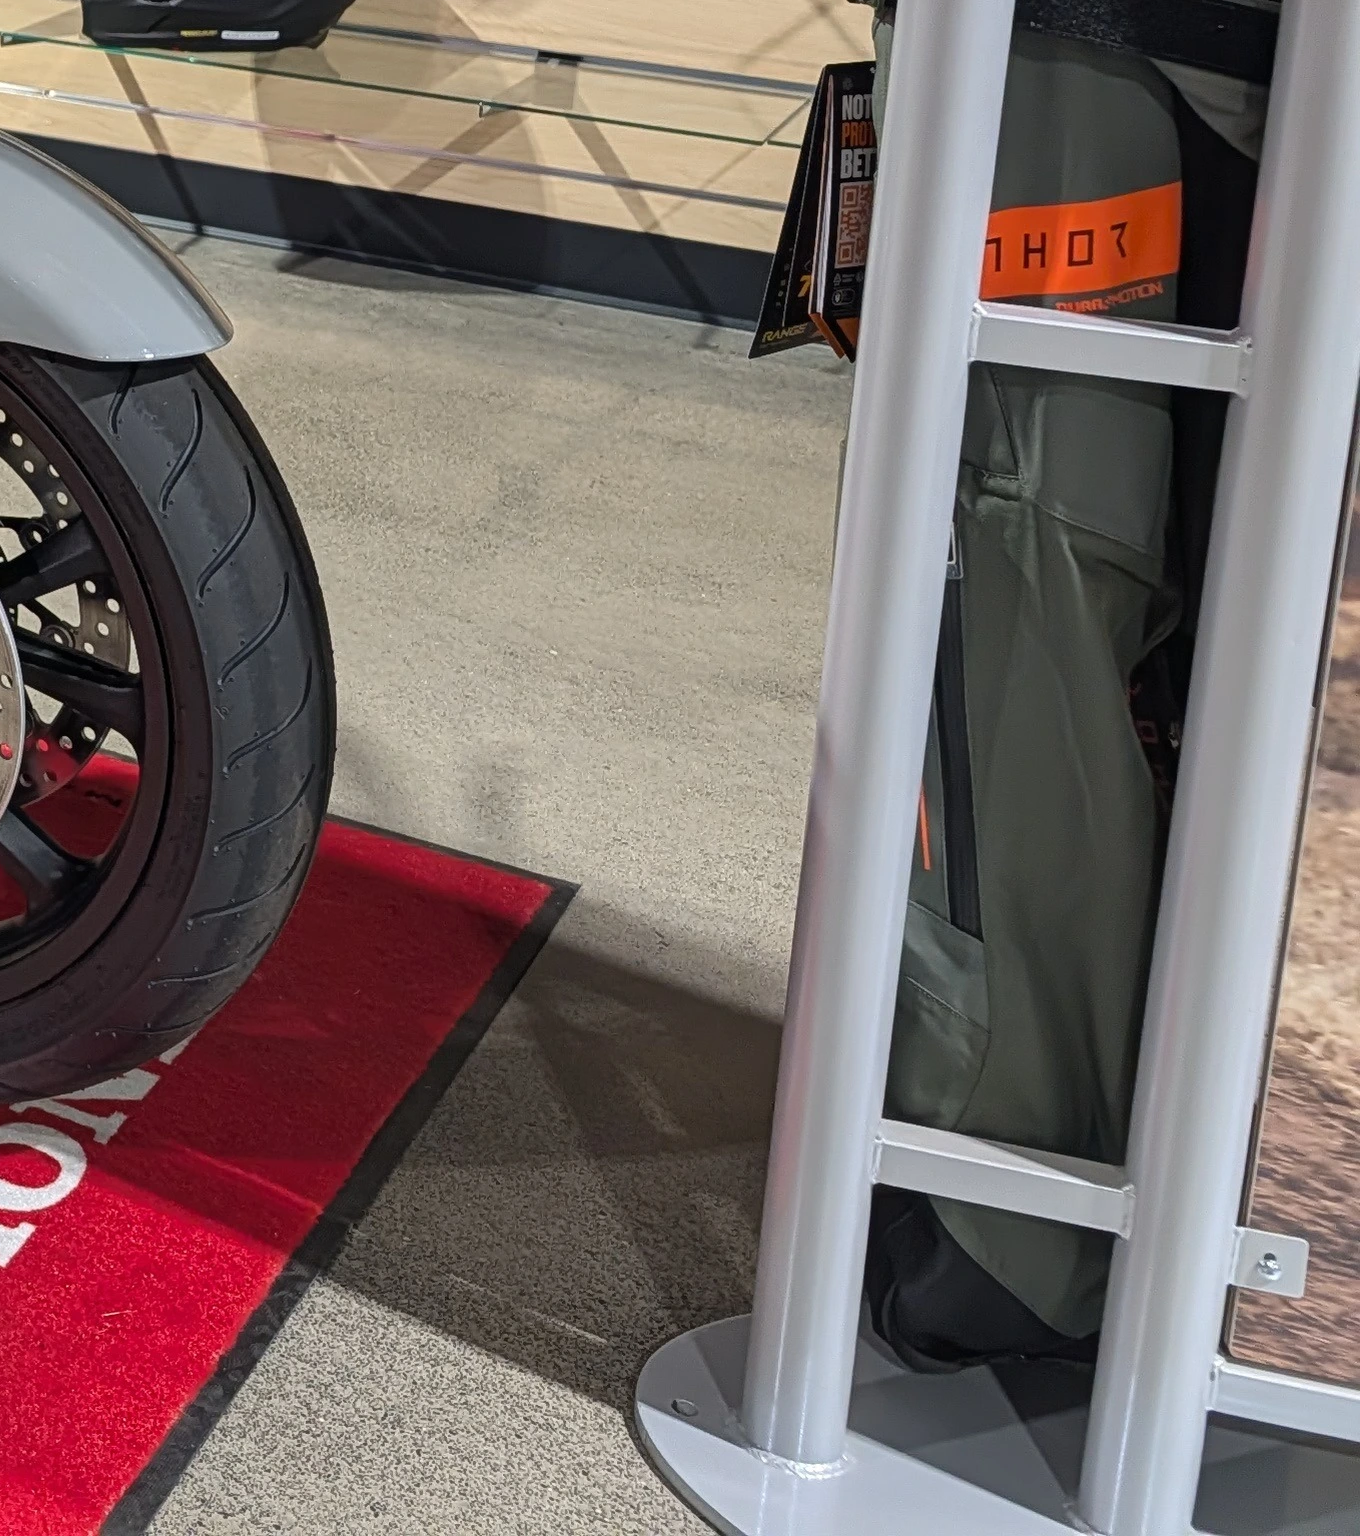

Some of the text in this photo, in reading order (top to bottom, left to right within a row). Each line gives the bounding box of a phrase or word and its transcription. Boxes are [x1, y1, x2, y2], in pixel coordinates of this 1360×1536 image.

[842, 95, 874, 120] NOT
[841, 122, 875, 147] PROT
[840, 148, 877, 179] BET
[762, 322, 808, 343] RANGE
